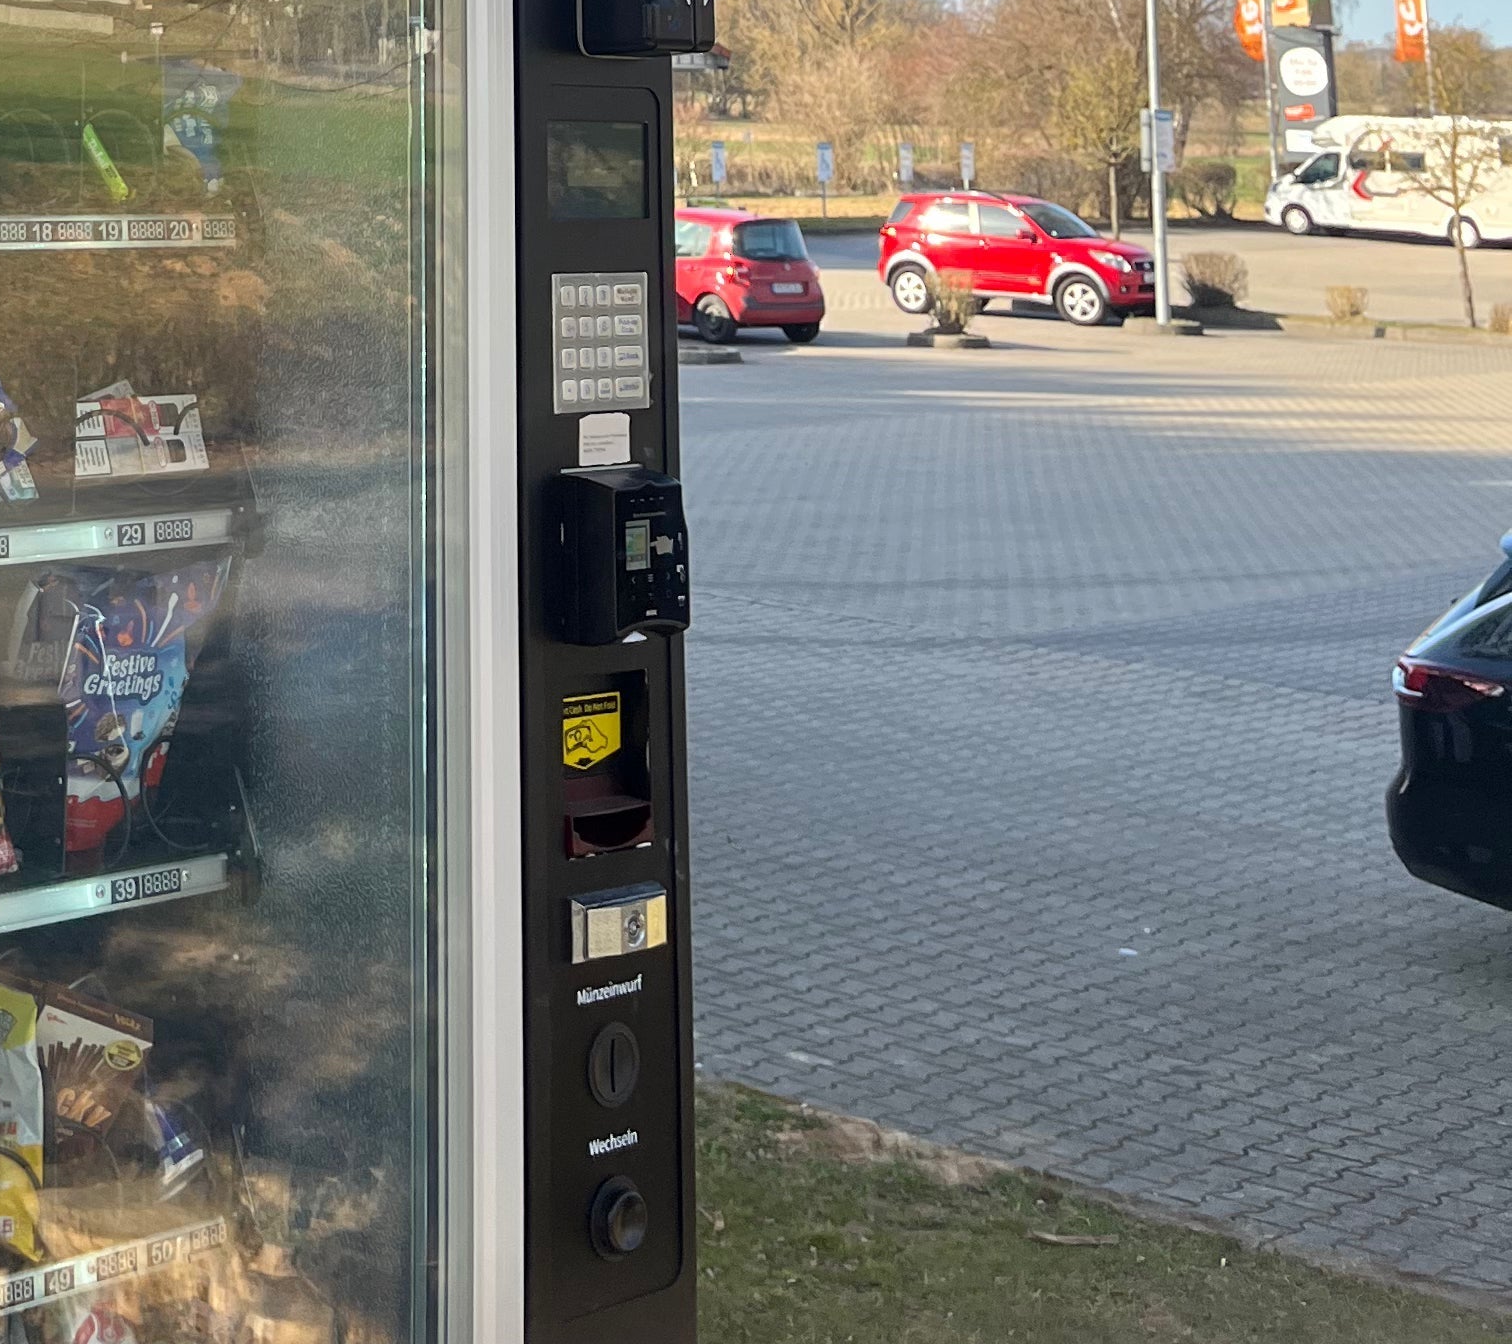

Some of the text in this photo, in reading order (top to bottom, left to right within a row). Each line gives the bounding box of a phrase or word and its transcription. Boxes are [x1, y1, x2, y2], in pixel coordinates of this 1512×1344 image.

[32, 223, 53, 242] 18
[97, 222, 119, 241] 19
[130, 221, 165, 240] 8888
[169, 220, 189, 240] 20
[121, 525, 143, 545] 29
[155, 520, 191, 540] 8888
[103, 654, 156, 678] Festive
[83, 671, 162, 701] Greetings
[115, 879, 136, 901] 39
[144, 870, 180, 893] 8888
[576, 974, 644, 1006] Münzeinwurf
[588, 1128, 639, 1157] Wechseln
[47, 1269, 71, 1291] 49
[151, 1241, 174, 1265] 50
